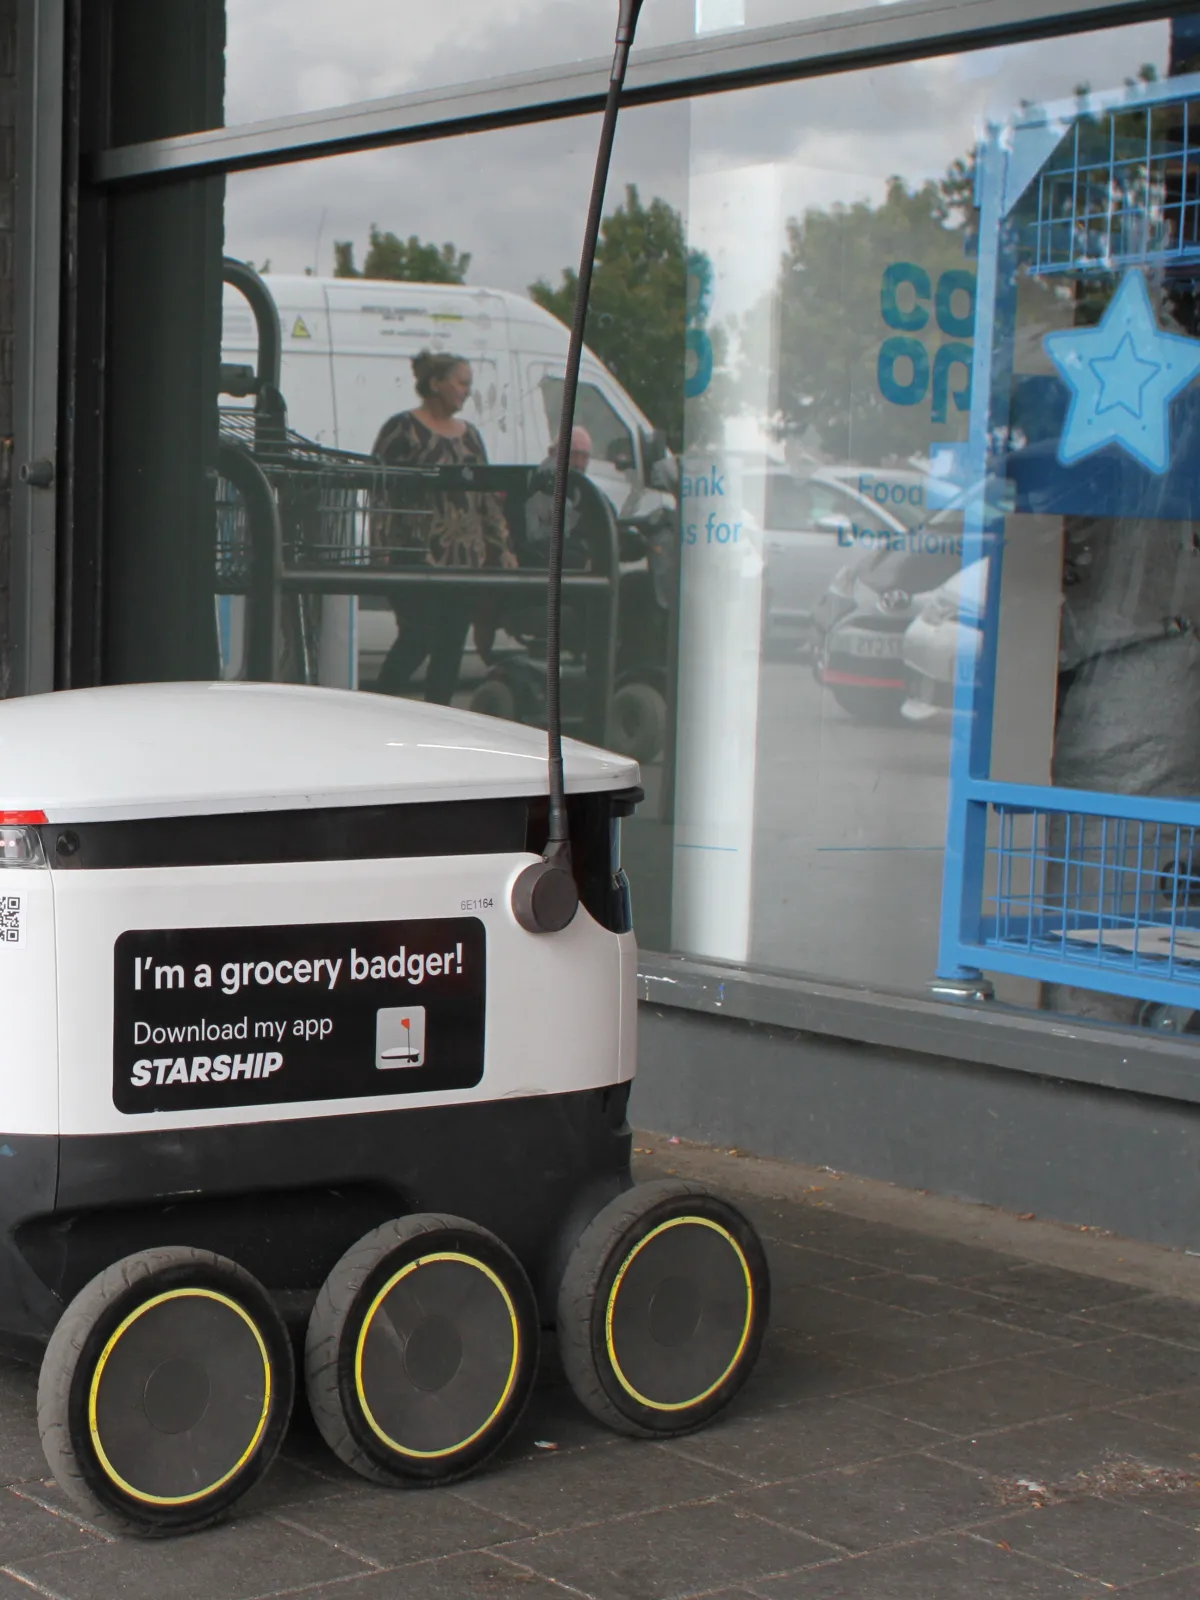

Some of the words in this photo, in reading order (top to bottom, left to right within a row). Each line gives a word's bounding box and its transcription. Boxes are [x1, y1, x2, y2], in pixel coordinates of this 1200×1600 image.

[681, 465, 724, 498] ank
[859, 473, 924, 506] Food
[706, 512, 743, 546] for
[460, 898, 494, 911] 6E1164
[134, 956, 185, 990] I'm
[194, 964, 212, 987] a
[221, 956, 342, 995] grocery
[350, 943, 464, 985] badger!
[134, 1017, 249, 1045] Download
[254, 1019, 287, 1042] my
[292, 1016, 334, 1040] app
[130, 1051, 284, 1087] STARSHIP
